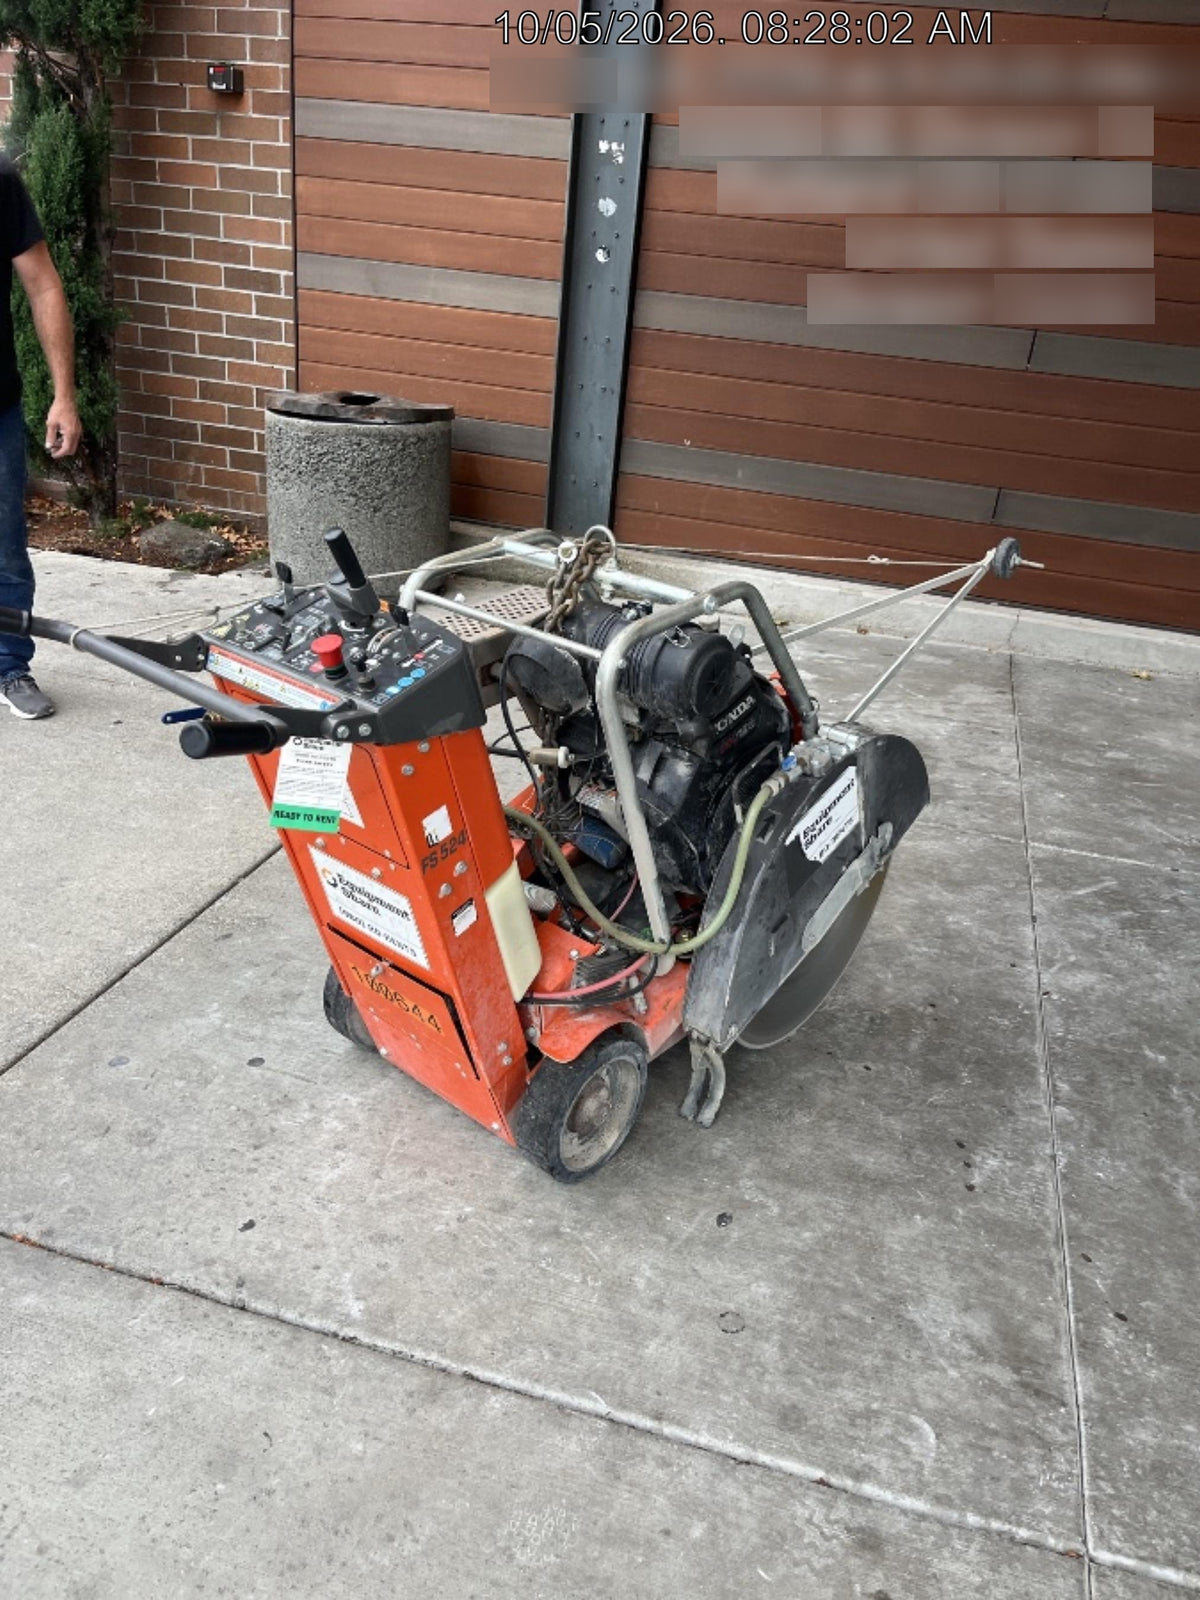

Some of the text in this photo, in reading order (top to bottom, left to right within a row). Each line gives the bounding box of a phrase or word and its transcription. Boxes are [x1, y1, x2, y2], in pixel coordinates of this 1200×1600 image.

[274, 809, 337, 824] READY TO RENT
[804, 816, 833, 851] Share
